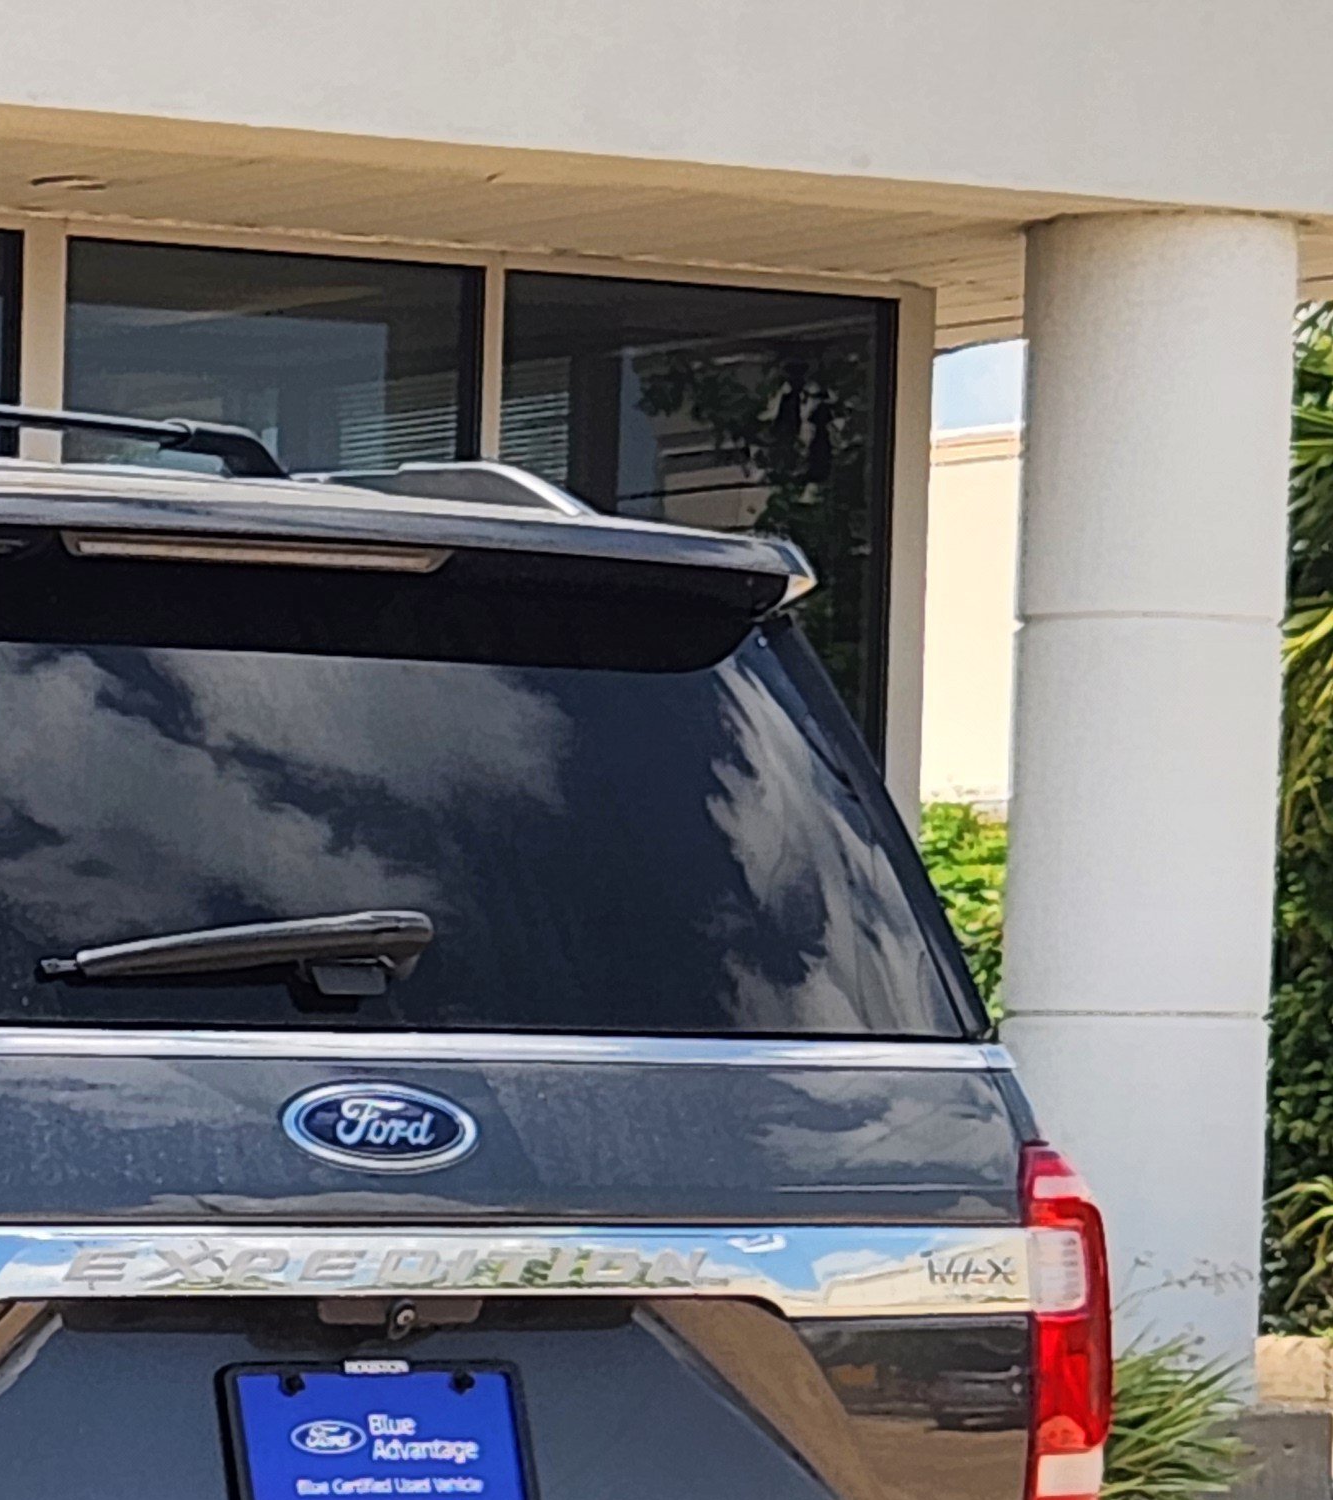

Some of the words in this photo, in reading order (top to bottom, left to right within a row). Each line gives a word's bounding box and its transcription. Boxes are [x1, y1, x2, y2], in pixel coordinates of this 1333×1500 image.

[336, 1098, 435, 1145] Ford
[62, 1247, 709, 1284] EXPEDITION
[305, 1424, 354, 1449] Ford
[368, 1413, 417, 1437] Blue
[372, 1438, 481, 1464] Advantage
